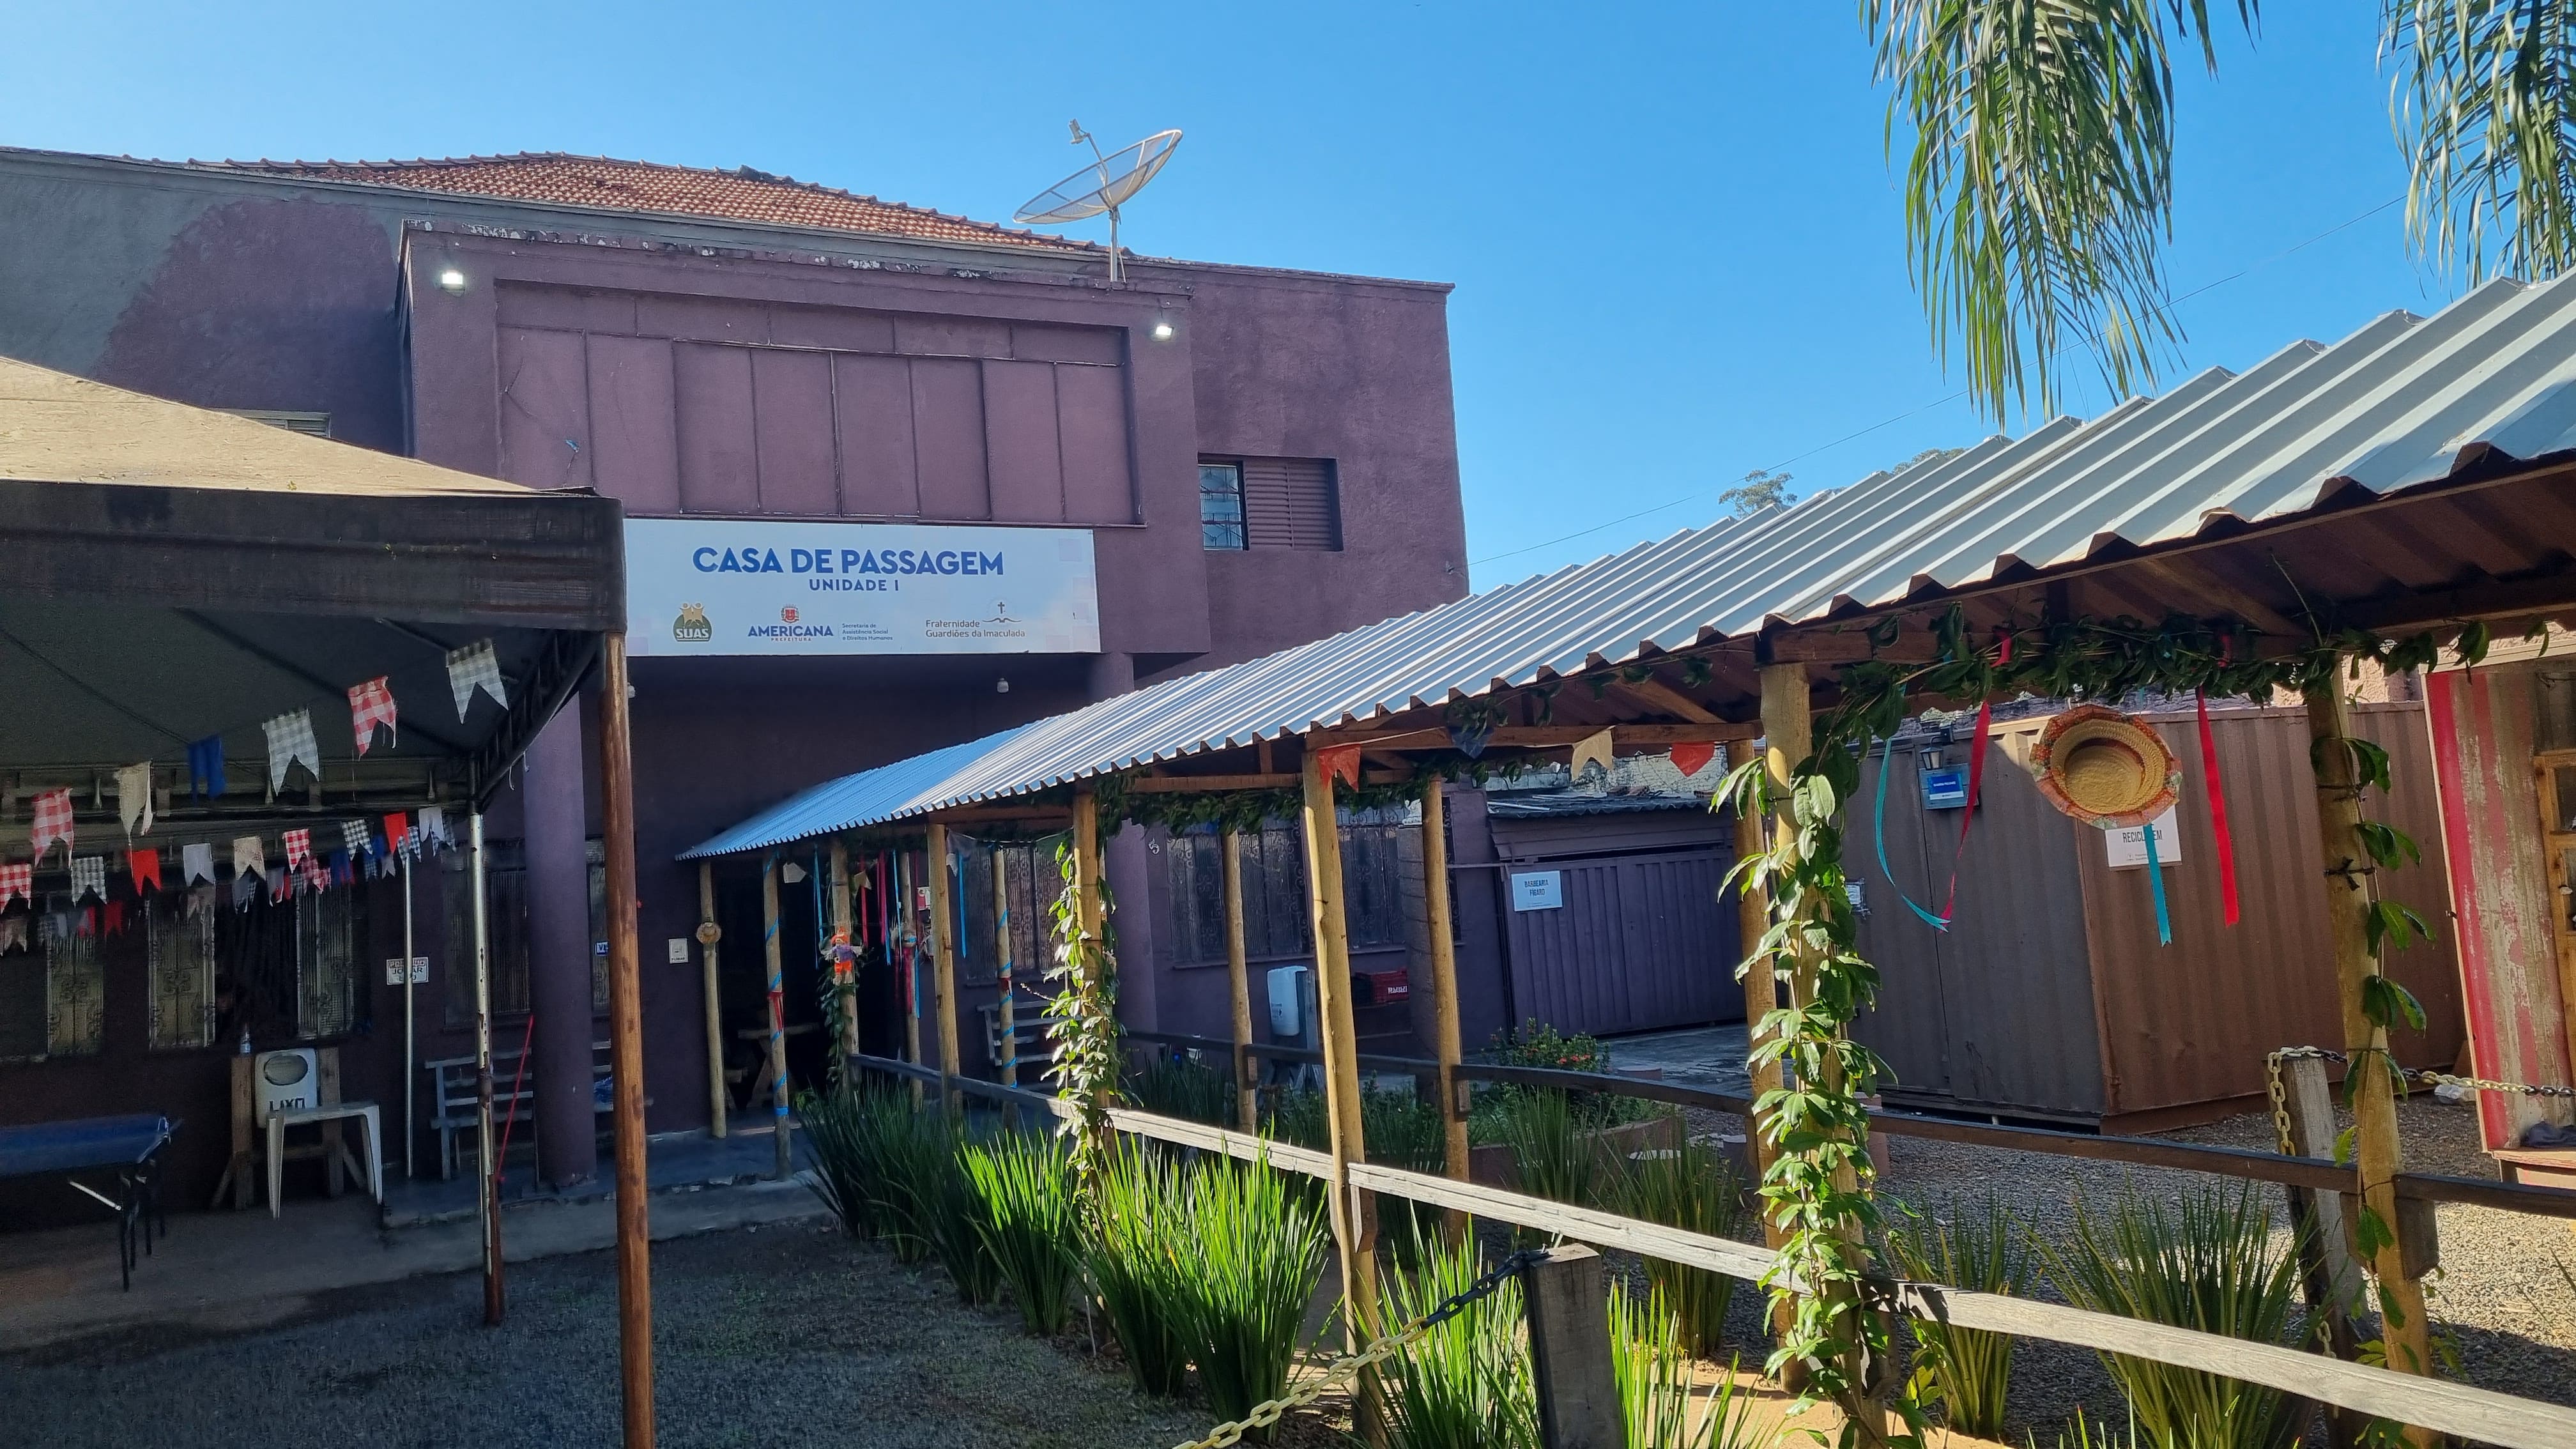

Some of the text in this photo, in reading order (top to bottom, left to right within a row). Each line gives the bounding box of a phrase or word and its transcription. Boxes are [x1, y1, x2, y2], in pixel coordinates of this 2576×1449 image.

[693, 548, 1003, 575] CASA DE PASSAGEM
[809, 579, 899, 591] UNIDADE I
[676, 628, 709, 638] SUAS
[747, 625, 834, 637] AMERICANA
[2122, 830, 2163, 843] RECICLEM
